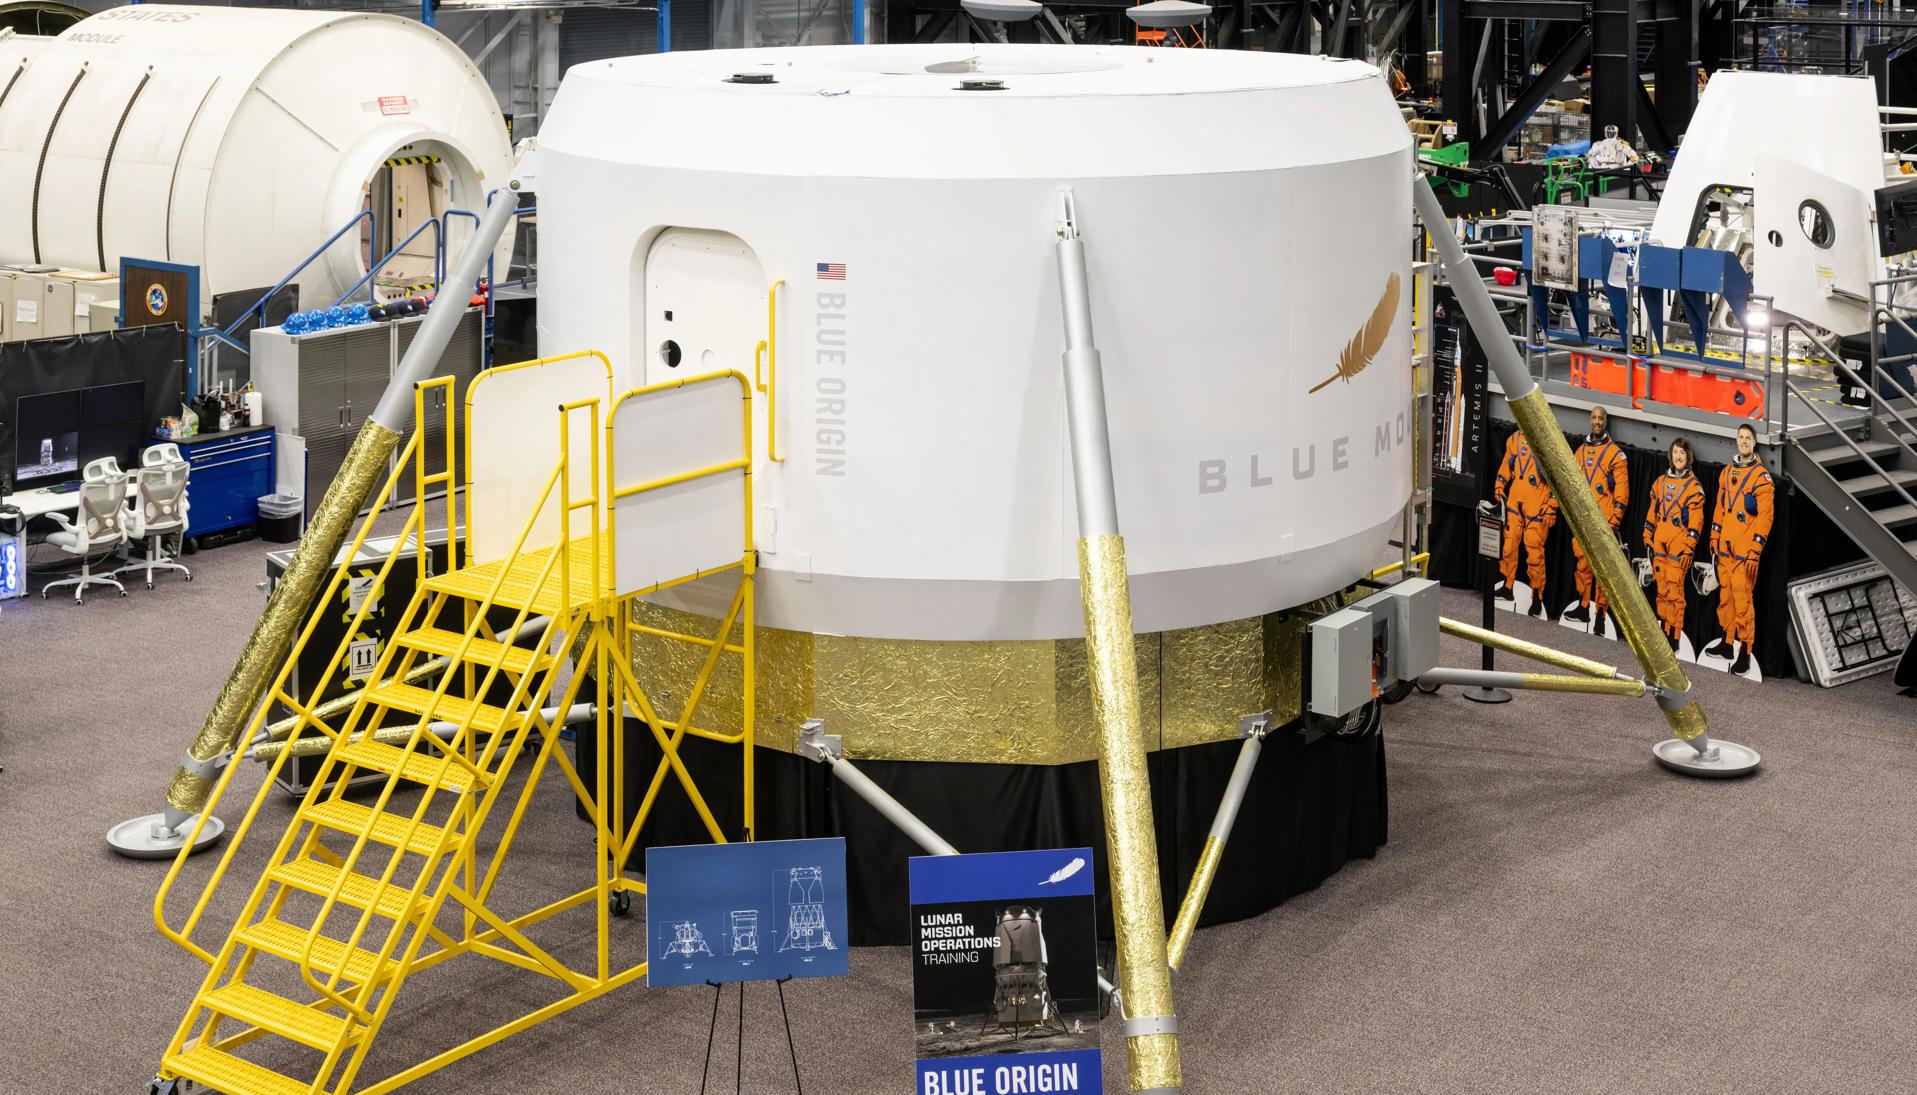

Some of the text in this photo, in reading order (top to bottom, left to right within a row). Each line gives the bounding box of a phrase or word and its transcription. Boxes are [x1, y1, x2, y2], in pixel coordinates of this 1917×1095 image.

[98, 10, 200, 23] STATES
[66, 33, 126, 44] MODULE
[816, 292, 847, 477] BLUE ORIGIN
[1471, 383, 1483, 453] ARTEMIS
[1199, 436, 1349, 495] BLUE
[1375, 404, 1411, 458] MO
[920, 913, 963, 926] LUNAR
[921, 925, 974, 939] MISSION
[921, 936, 1001, 952] OPERATIONS
[921, 951, 979, 965] TRAINING
[924, 1062, 1078, 1095] BLUE ORIGIN
